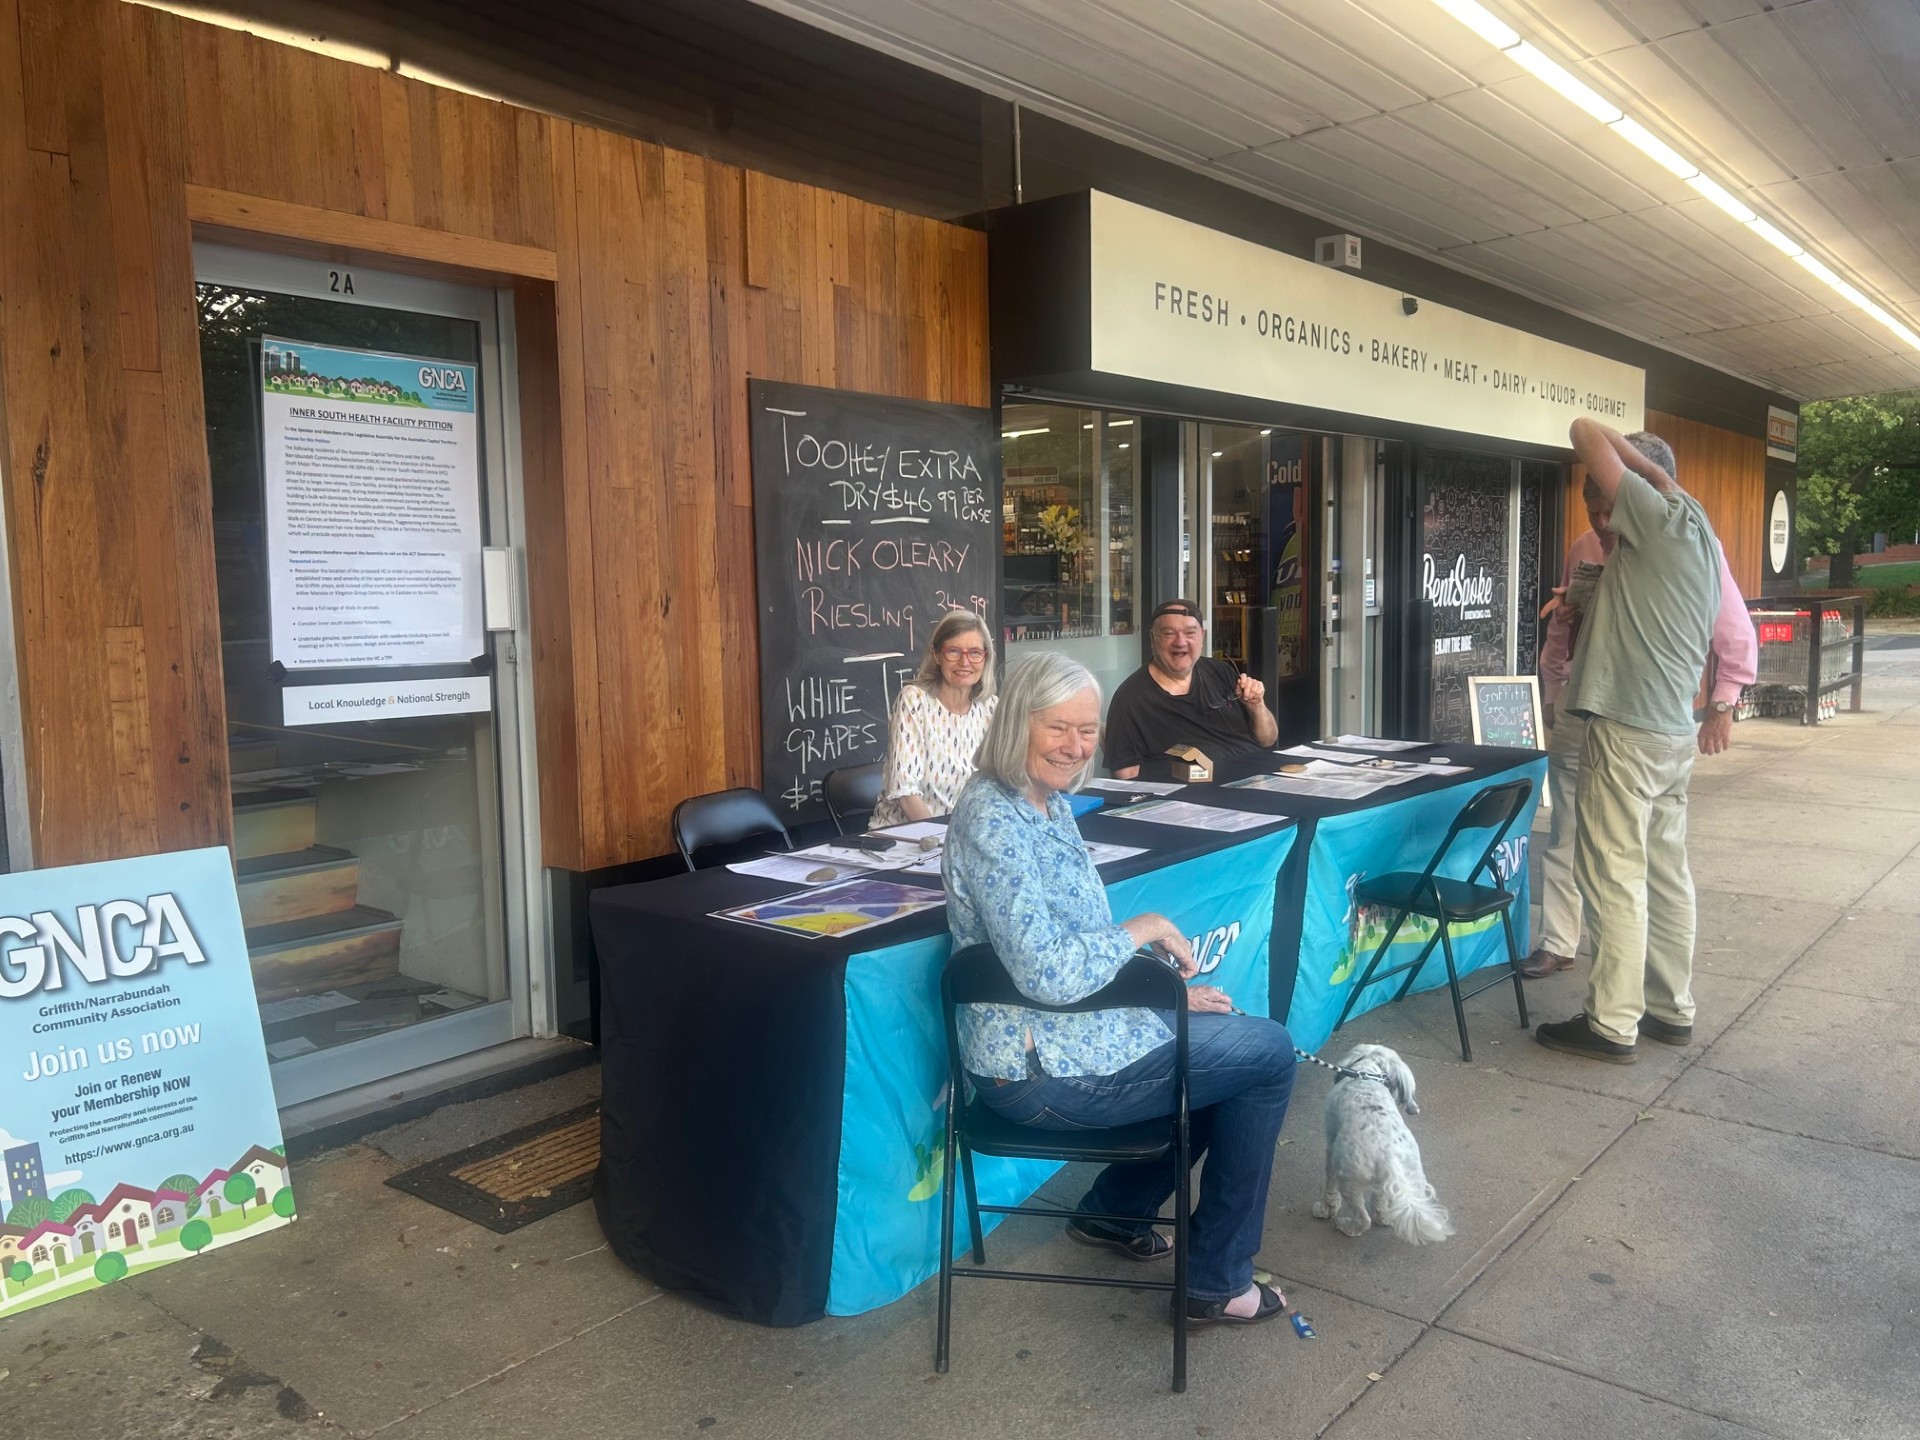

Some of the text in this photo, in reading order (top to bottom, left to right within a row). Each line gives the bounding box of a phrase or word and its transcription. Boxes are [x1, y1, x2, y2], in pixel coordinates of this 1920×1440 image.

[329, 271, 354, 295] 2A
[1155, 282, 1627, 419] FRESH ORGANICS BAKERY MEAT DAIRY LIQUOR GOURMET
[418, 366, 467, 392] GNCA
[289, 406, 453, 430] INNER SOUTH HEALTH FACILITY PETITION
[899, 449, 982, 482] EXTRA
[1268, 458, 1302, 484] Cold
[829, 478, 882, 512] DRY
[961, 486, 984, 504] PER
[961, 506, 991, 524] CASE
[796, 537, 970, 582] NICK OLEARY
[802, 586, 914, 651] RIESLING
[308, 691, 471, 710] Local Knowledge & National Strength
[785, 676, 862, 723] WHITE
[785, 723, 878, 775] GRAPES
[0, 892, 206, 999] GNCA
[32, 996, 181, 1035] Community Association
[38, 983, 171, 1018] Griffith/Narrabundah
[23, 1022, 202, 1082] Join us now
[51, 1075, 191, 1123] your Membership NOW
[74, 1068, 162, 1098] Join or Renew
[49, 1095, 198, 1138] Protecting the amenity and interests of the
[58, 1104, 194, 1144] Griffith and Narrabundah communities
[64, 1123, 195, 1165] https://www.gnca.org.au
